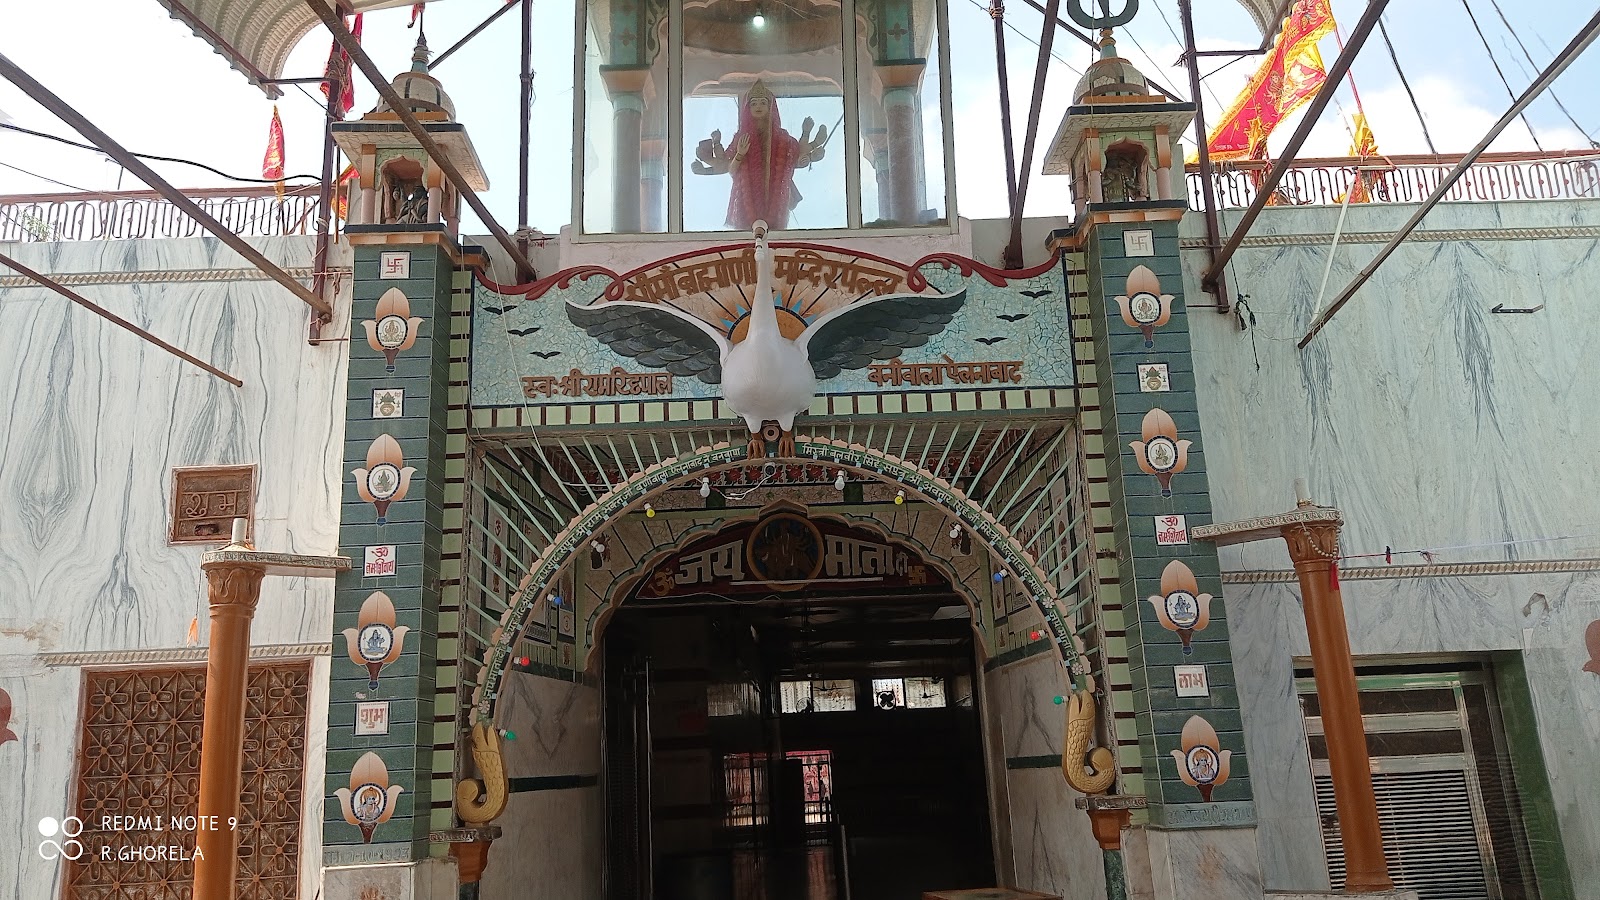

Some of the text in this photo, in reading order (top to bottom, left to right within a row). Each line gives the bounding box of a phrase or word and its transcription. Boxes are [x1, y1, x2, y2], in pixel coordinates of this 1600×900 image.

[675, 540, 745, 585] जय
[824, 535, 895, 576] माता
[1179, 674, 1204, 689] लाभ
[360, 708, 385, 729] शुभ
